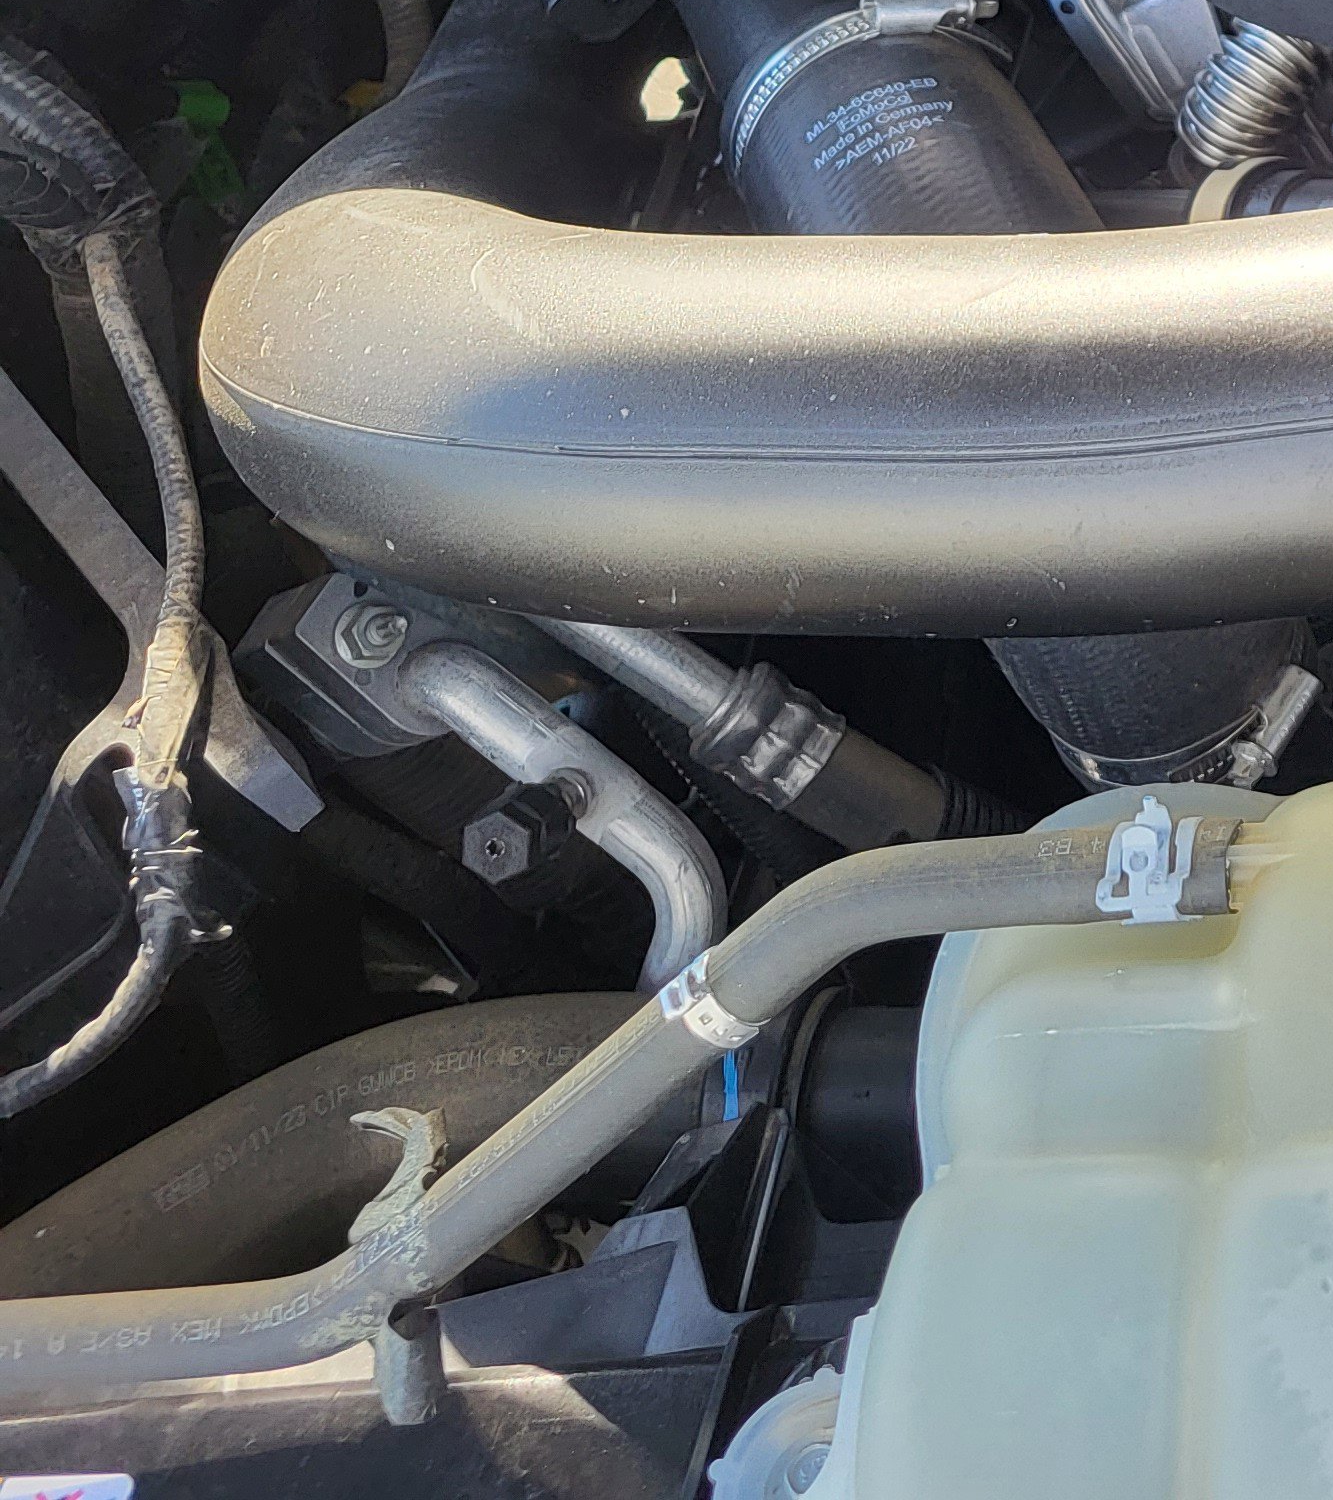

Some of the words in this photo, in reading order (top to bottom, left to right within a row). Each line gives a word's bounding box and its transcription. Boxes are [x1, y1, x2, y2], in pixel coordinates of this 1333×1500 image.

[837, 91, 913, 133] FoMoCo
[812, 132, 856, 171] Made
[857, 121, 874, 135] in
[875, 99, 954, 126] Germany
[871, 136, 918, 167] 11/22
